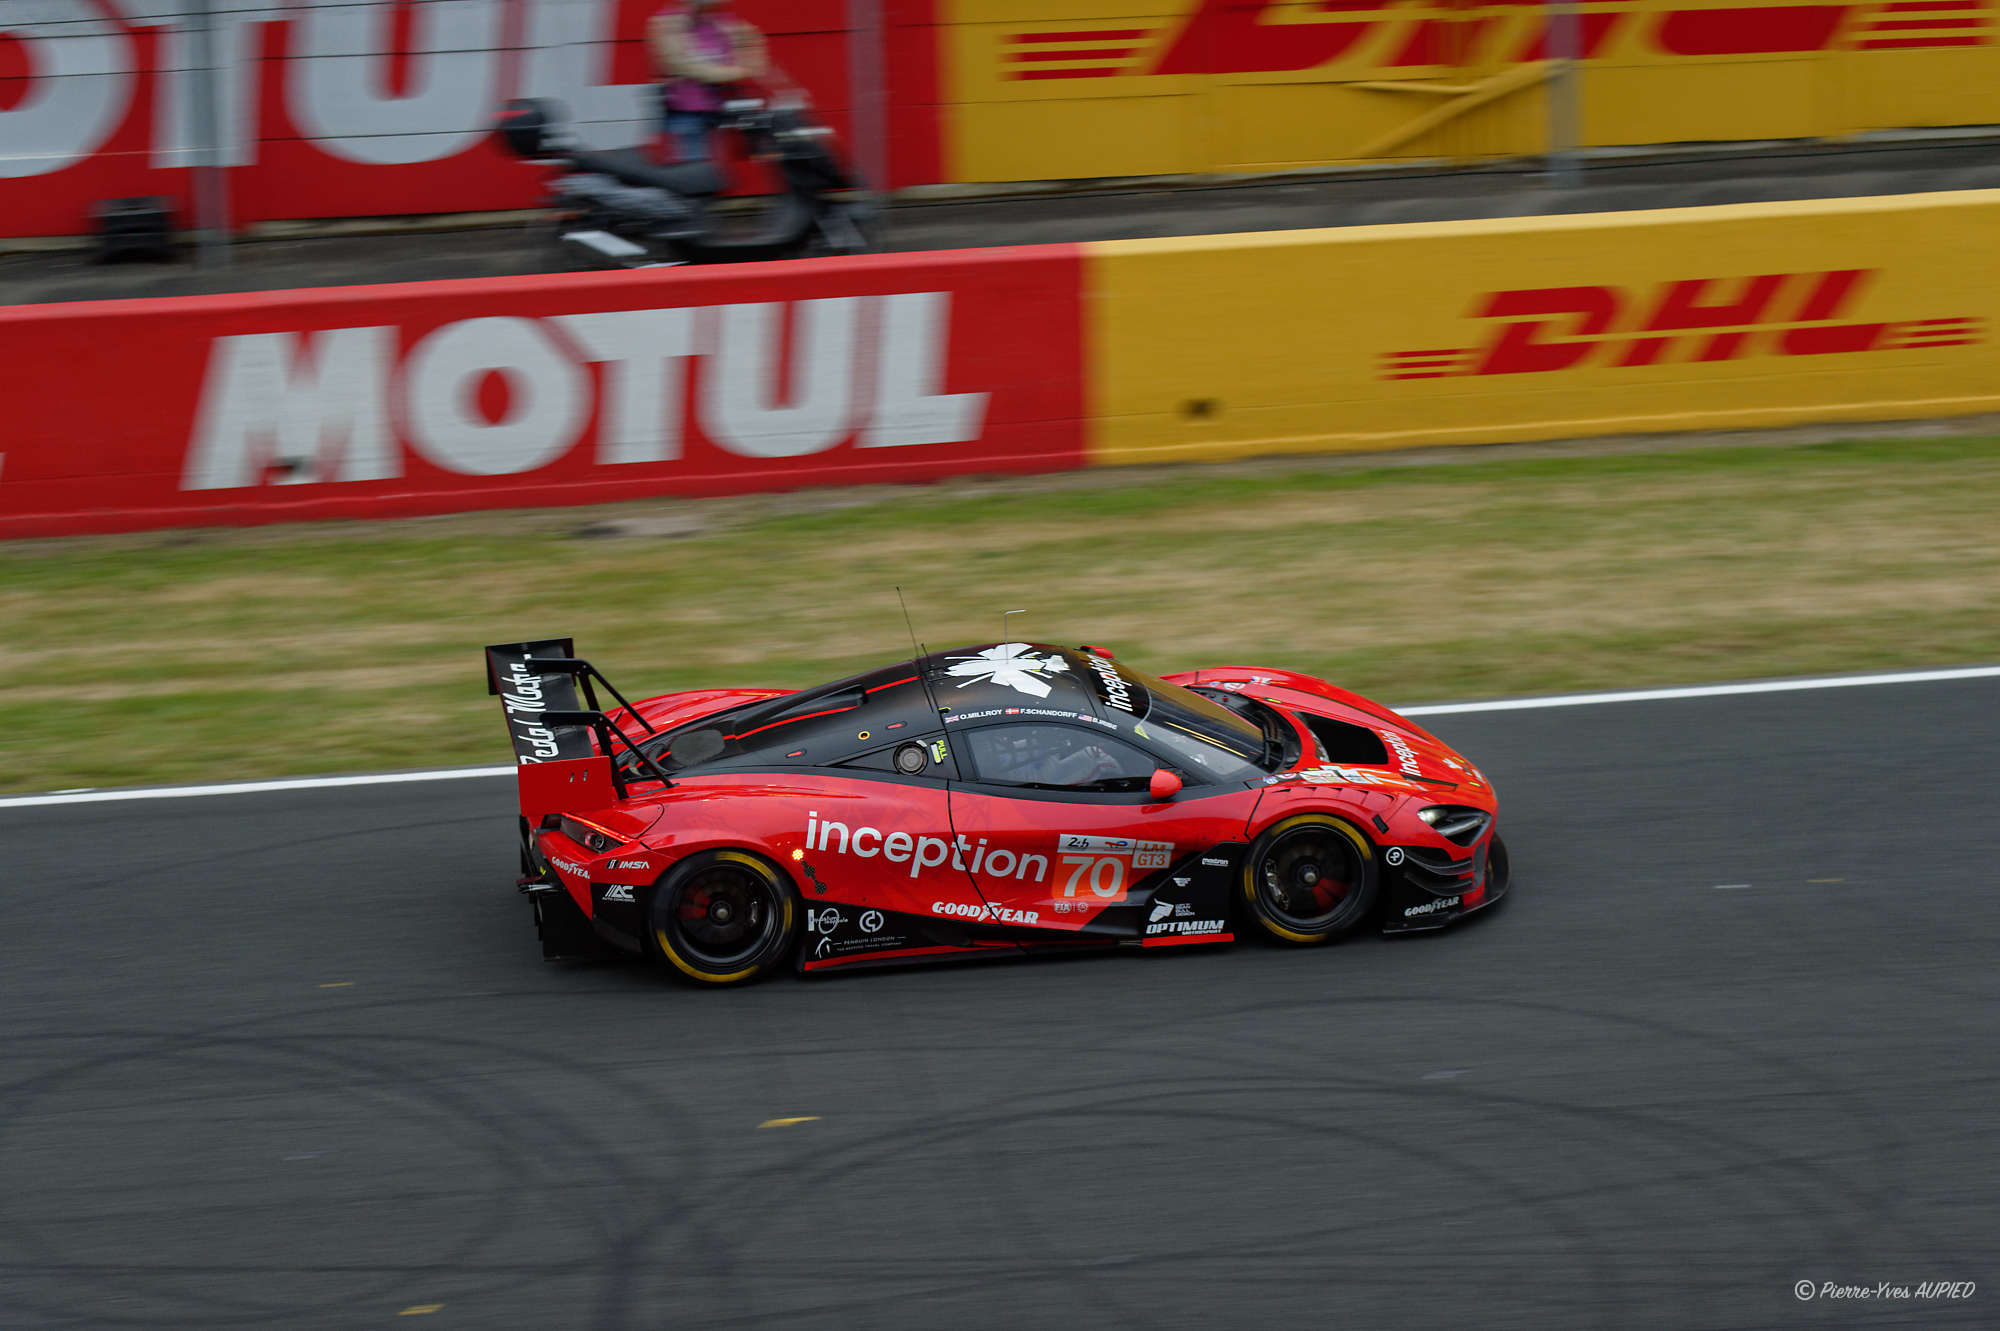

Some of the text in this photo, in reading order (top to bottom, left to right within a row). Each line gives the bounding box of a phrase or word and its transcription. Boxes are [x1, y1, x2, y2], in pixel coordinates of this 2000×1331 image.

[1465, 269, 1890, 376] DHL
[180, 291, 991, 492] MOTUL
[960, 708, 1078, 721] O.MILLROY F.SCHANDORFF
[936, 740, 948, 760] PULL
[805, 810, 1049, 882] inception
[1138, 854, 1165, 866] GT3
[1062, 855, 1124, 898] 70
[932, 901, 1039, 924] GOODYEAR
[1404, 896, 1459, 916] GOODYEAR
[1146, 919, 1225, 934] OPTIMUM
